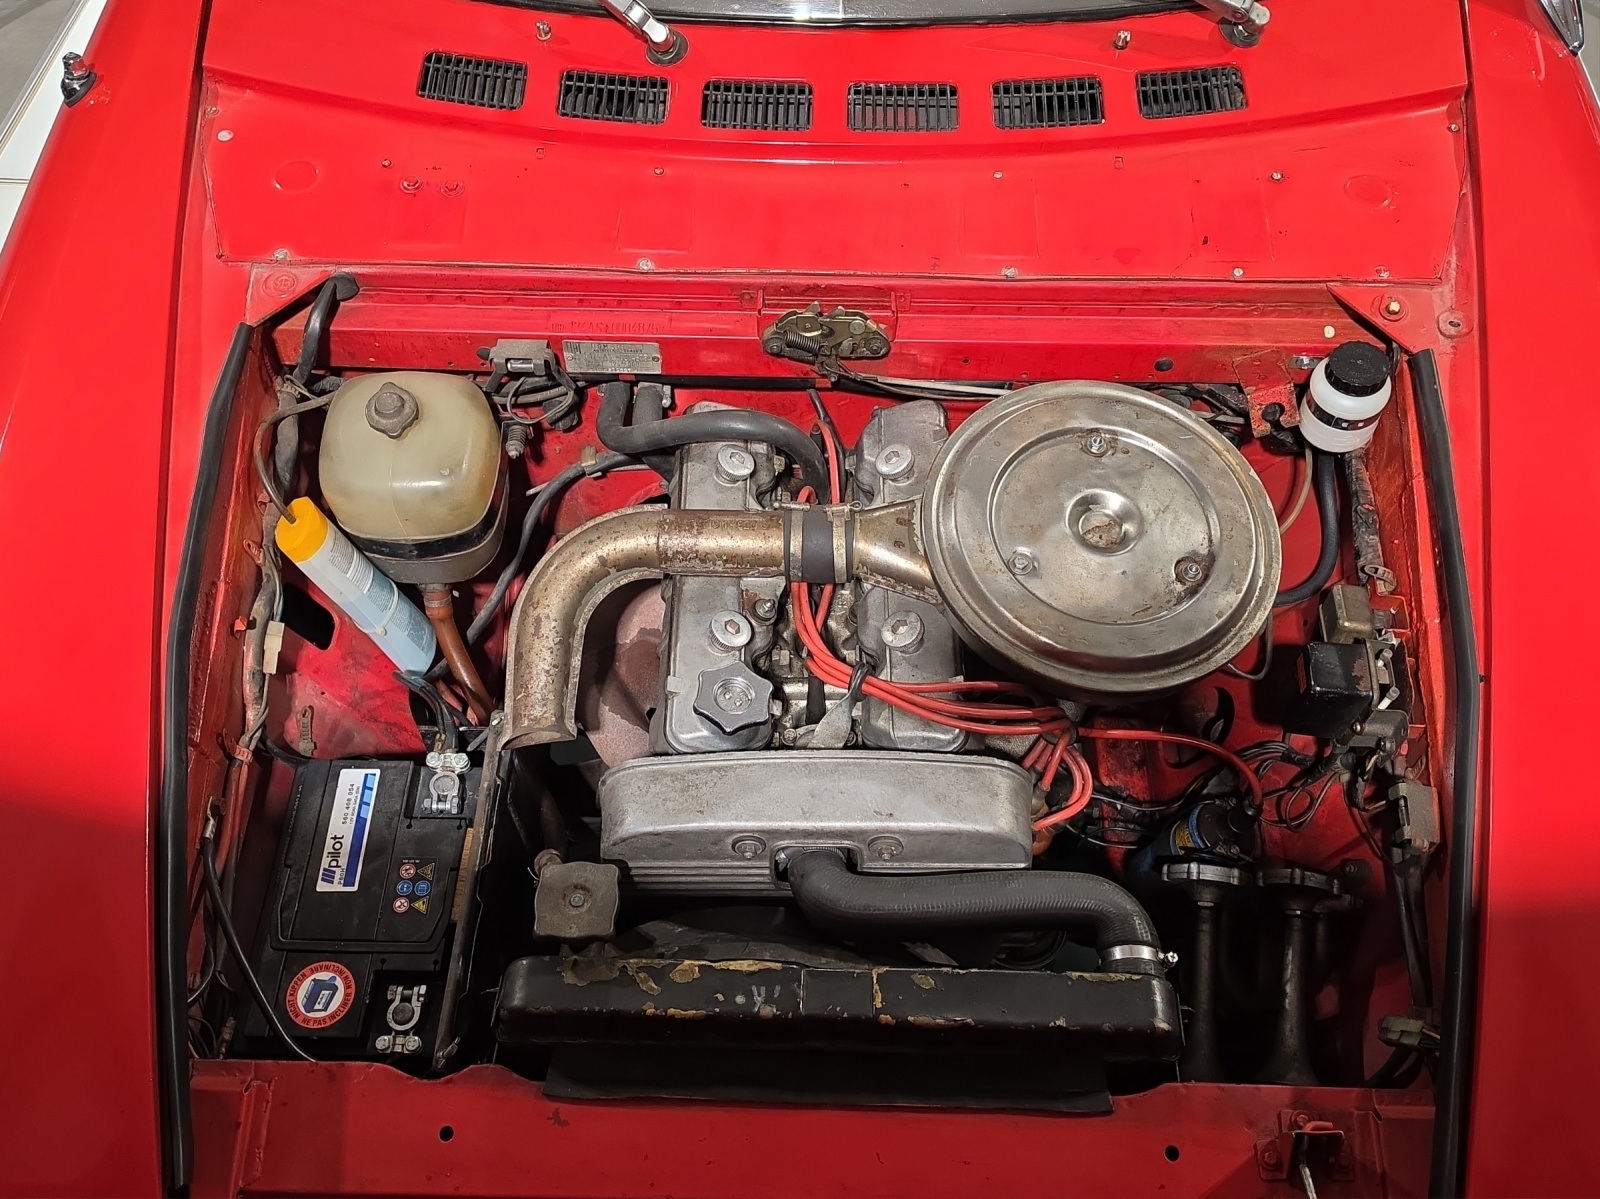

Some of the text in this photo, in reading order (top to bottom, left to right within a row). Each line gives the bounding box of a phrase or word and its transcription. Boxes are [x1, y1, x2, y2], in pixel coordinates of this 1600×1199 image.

[326, 834, 345, 868] pilot
[309, 963, 353, 990] NON INCLINARE
[288, 972, 307, 1020] NICHT KIPPEN
[301, 1018, 312, 1026] NE
[312, 1019, 328, 1027] PAS
[328, 991, 353, 1022] INCLINER
